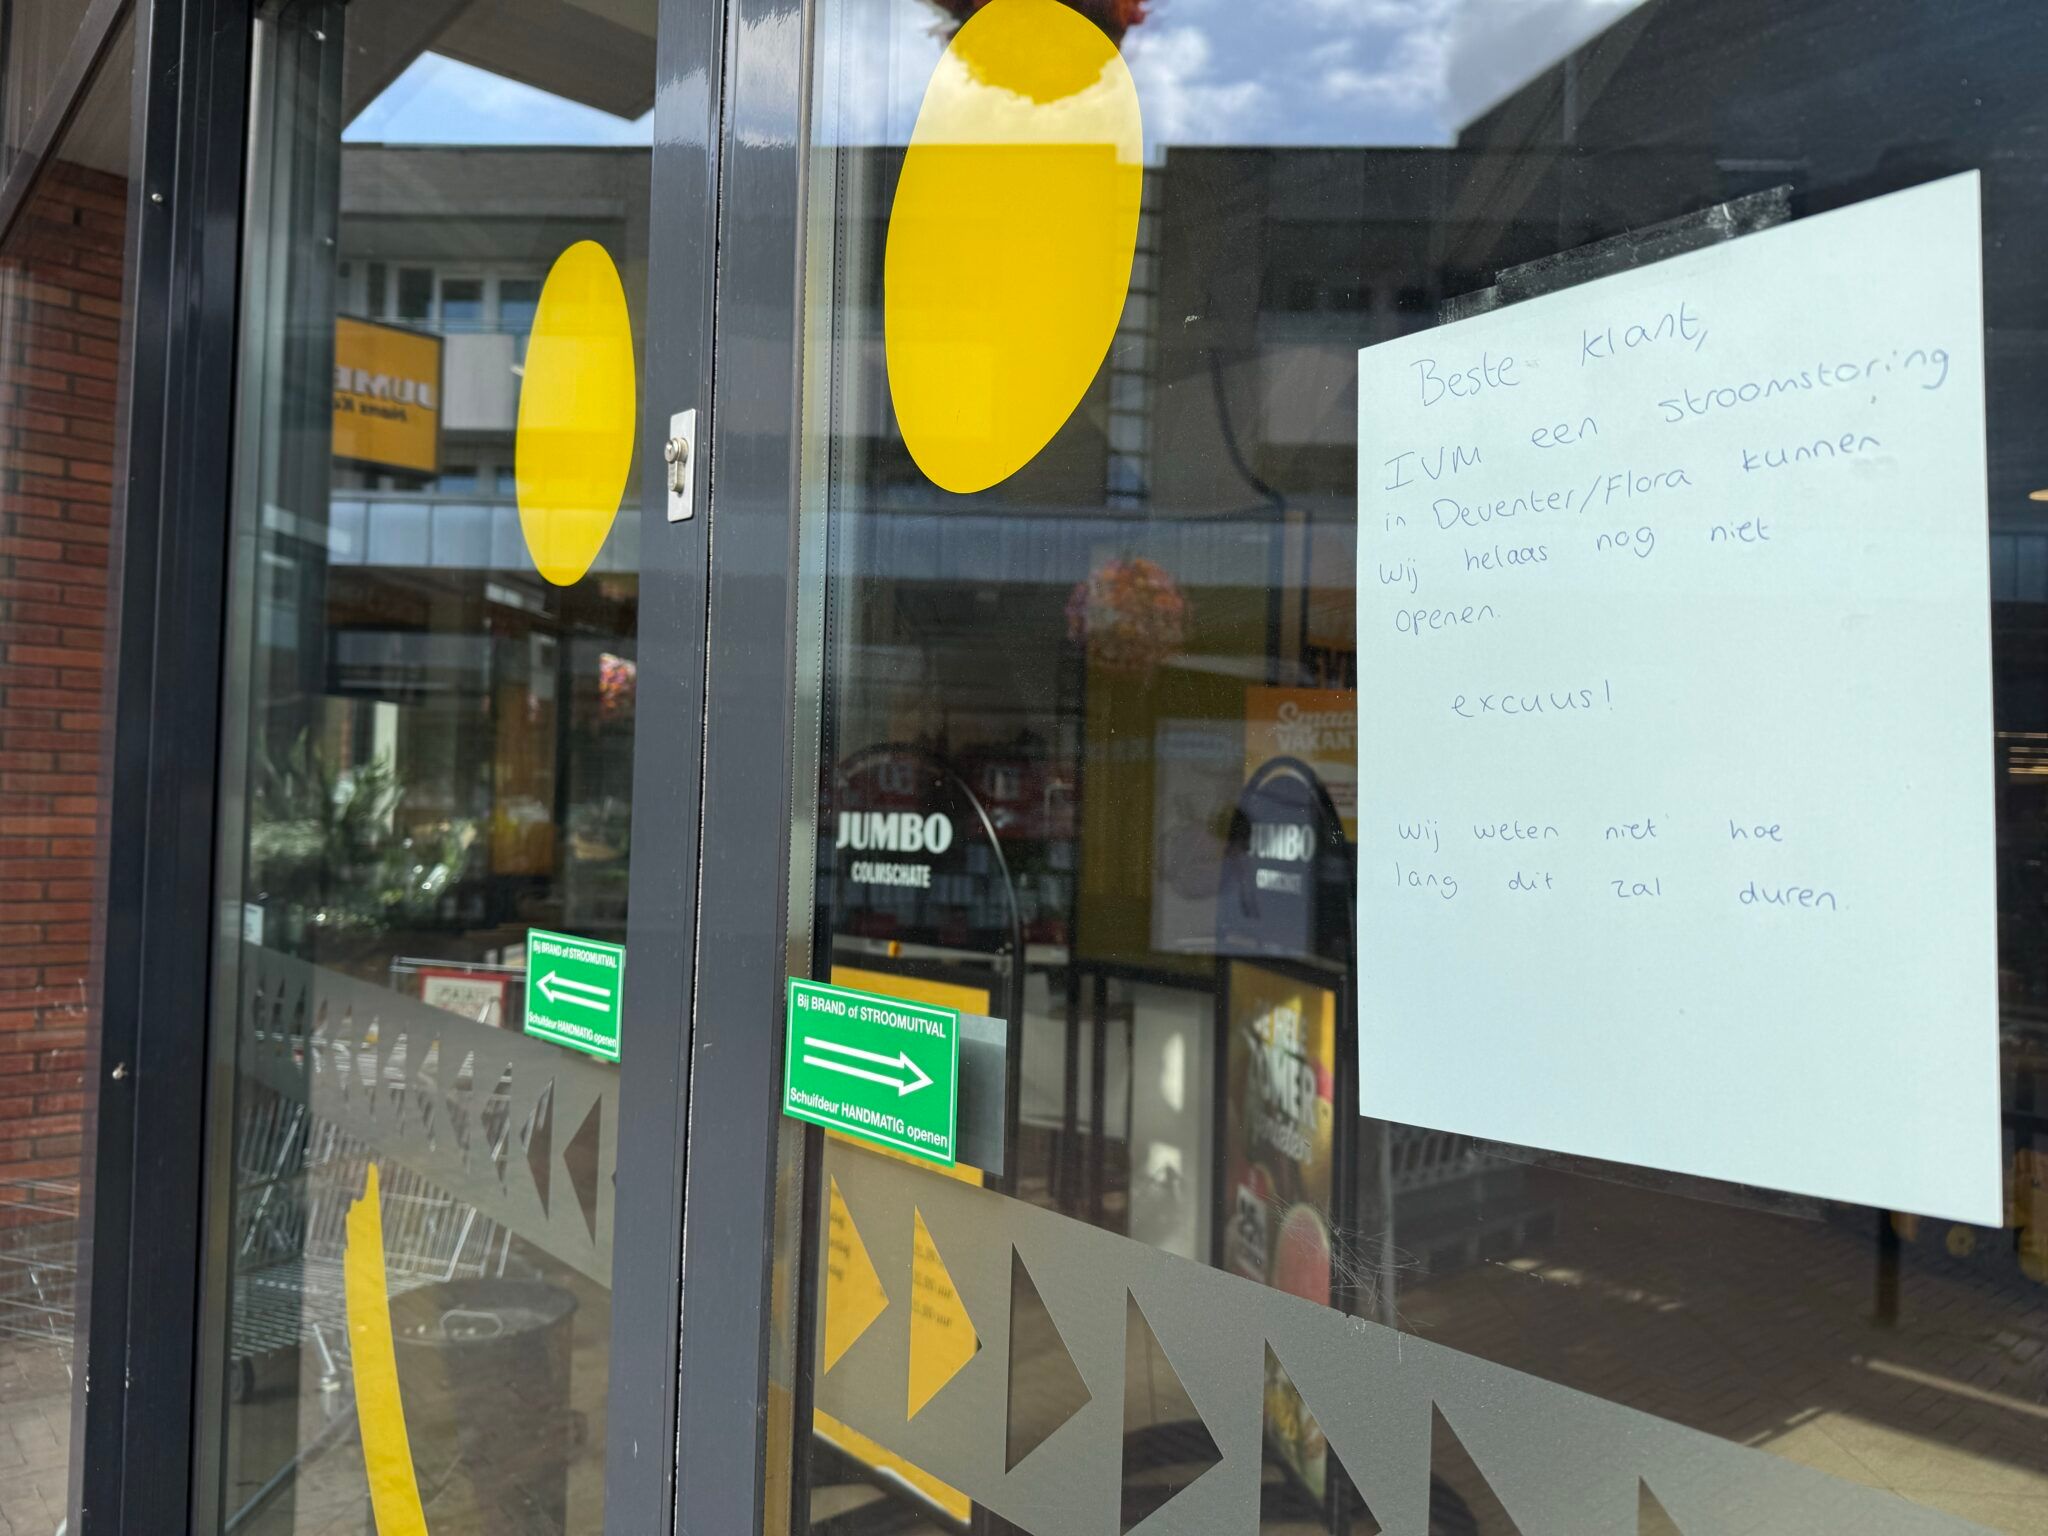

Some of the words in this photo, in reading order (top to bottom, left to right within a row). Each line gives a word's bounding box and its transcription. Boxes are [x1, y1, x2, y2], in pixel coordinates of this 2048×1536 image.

[1410, 352, 1520, 406] Beste
[1582, 302, 1708, 367] klant,
[1384, 446, 1482, 490] IVM
[1532, 417, 1598, 448] een
[1658, 349, 1950, 423] stroomstoring
[1385, 512, 1406, 531] in
[1432, 470, 1692, 529] Deventer/Flora
[1743, 433, 1881, 472] kunnen
[1464, 545, 1549, 571] helaas
[1597, 526, 1655, 558] nog
[1711, 520, 1770, 543] niet
[1452, 680, 1613, 717] excuus!
[836, 811, 953, 854] JUMBO
[1249, 822, 1316, 863] JUMBO
[1474, 820, 1559, 841] weten
[1605, 819, 1658, 841] niet
[1730, 819, 1784, 842] hoe
[1396, 861, 1458, 900] lang
[1508, 871, 1553, 891] dit
[1611, 876, 1661, 898] zal
[541, 942, 562, 957] BRAND
[569, 947, 617, 969] STROOMUITVAL
[558, 1020, 593, 1041] HANDMATIG
[797, 993, 810, 1011] Bij
[811, 996, 846, 1016] BRAND
[848, 1006, 859, 1018] of
[860, 1006, 946, 1038] STROOMUITVAL
[790, 1087, 840, 1114] Schuifdeur
[841, 1102, 905, 1135] HANDMATIG
[907, 1124, 948, 1148] openen
